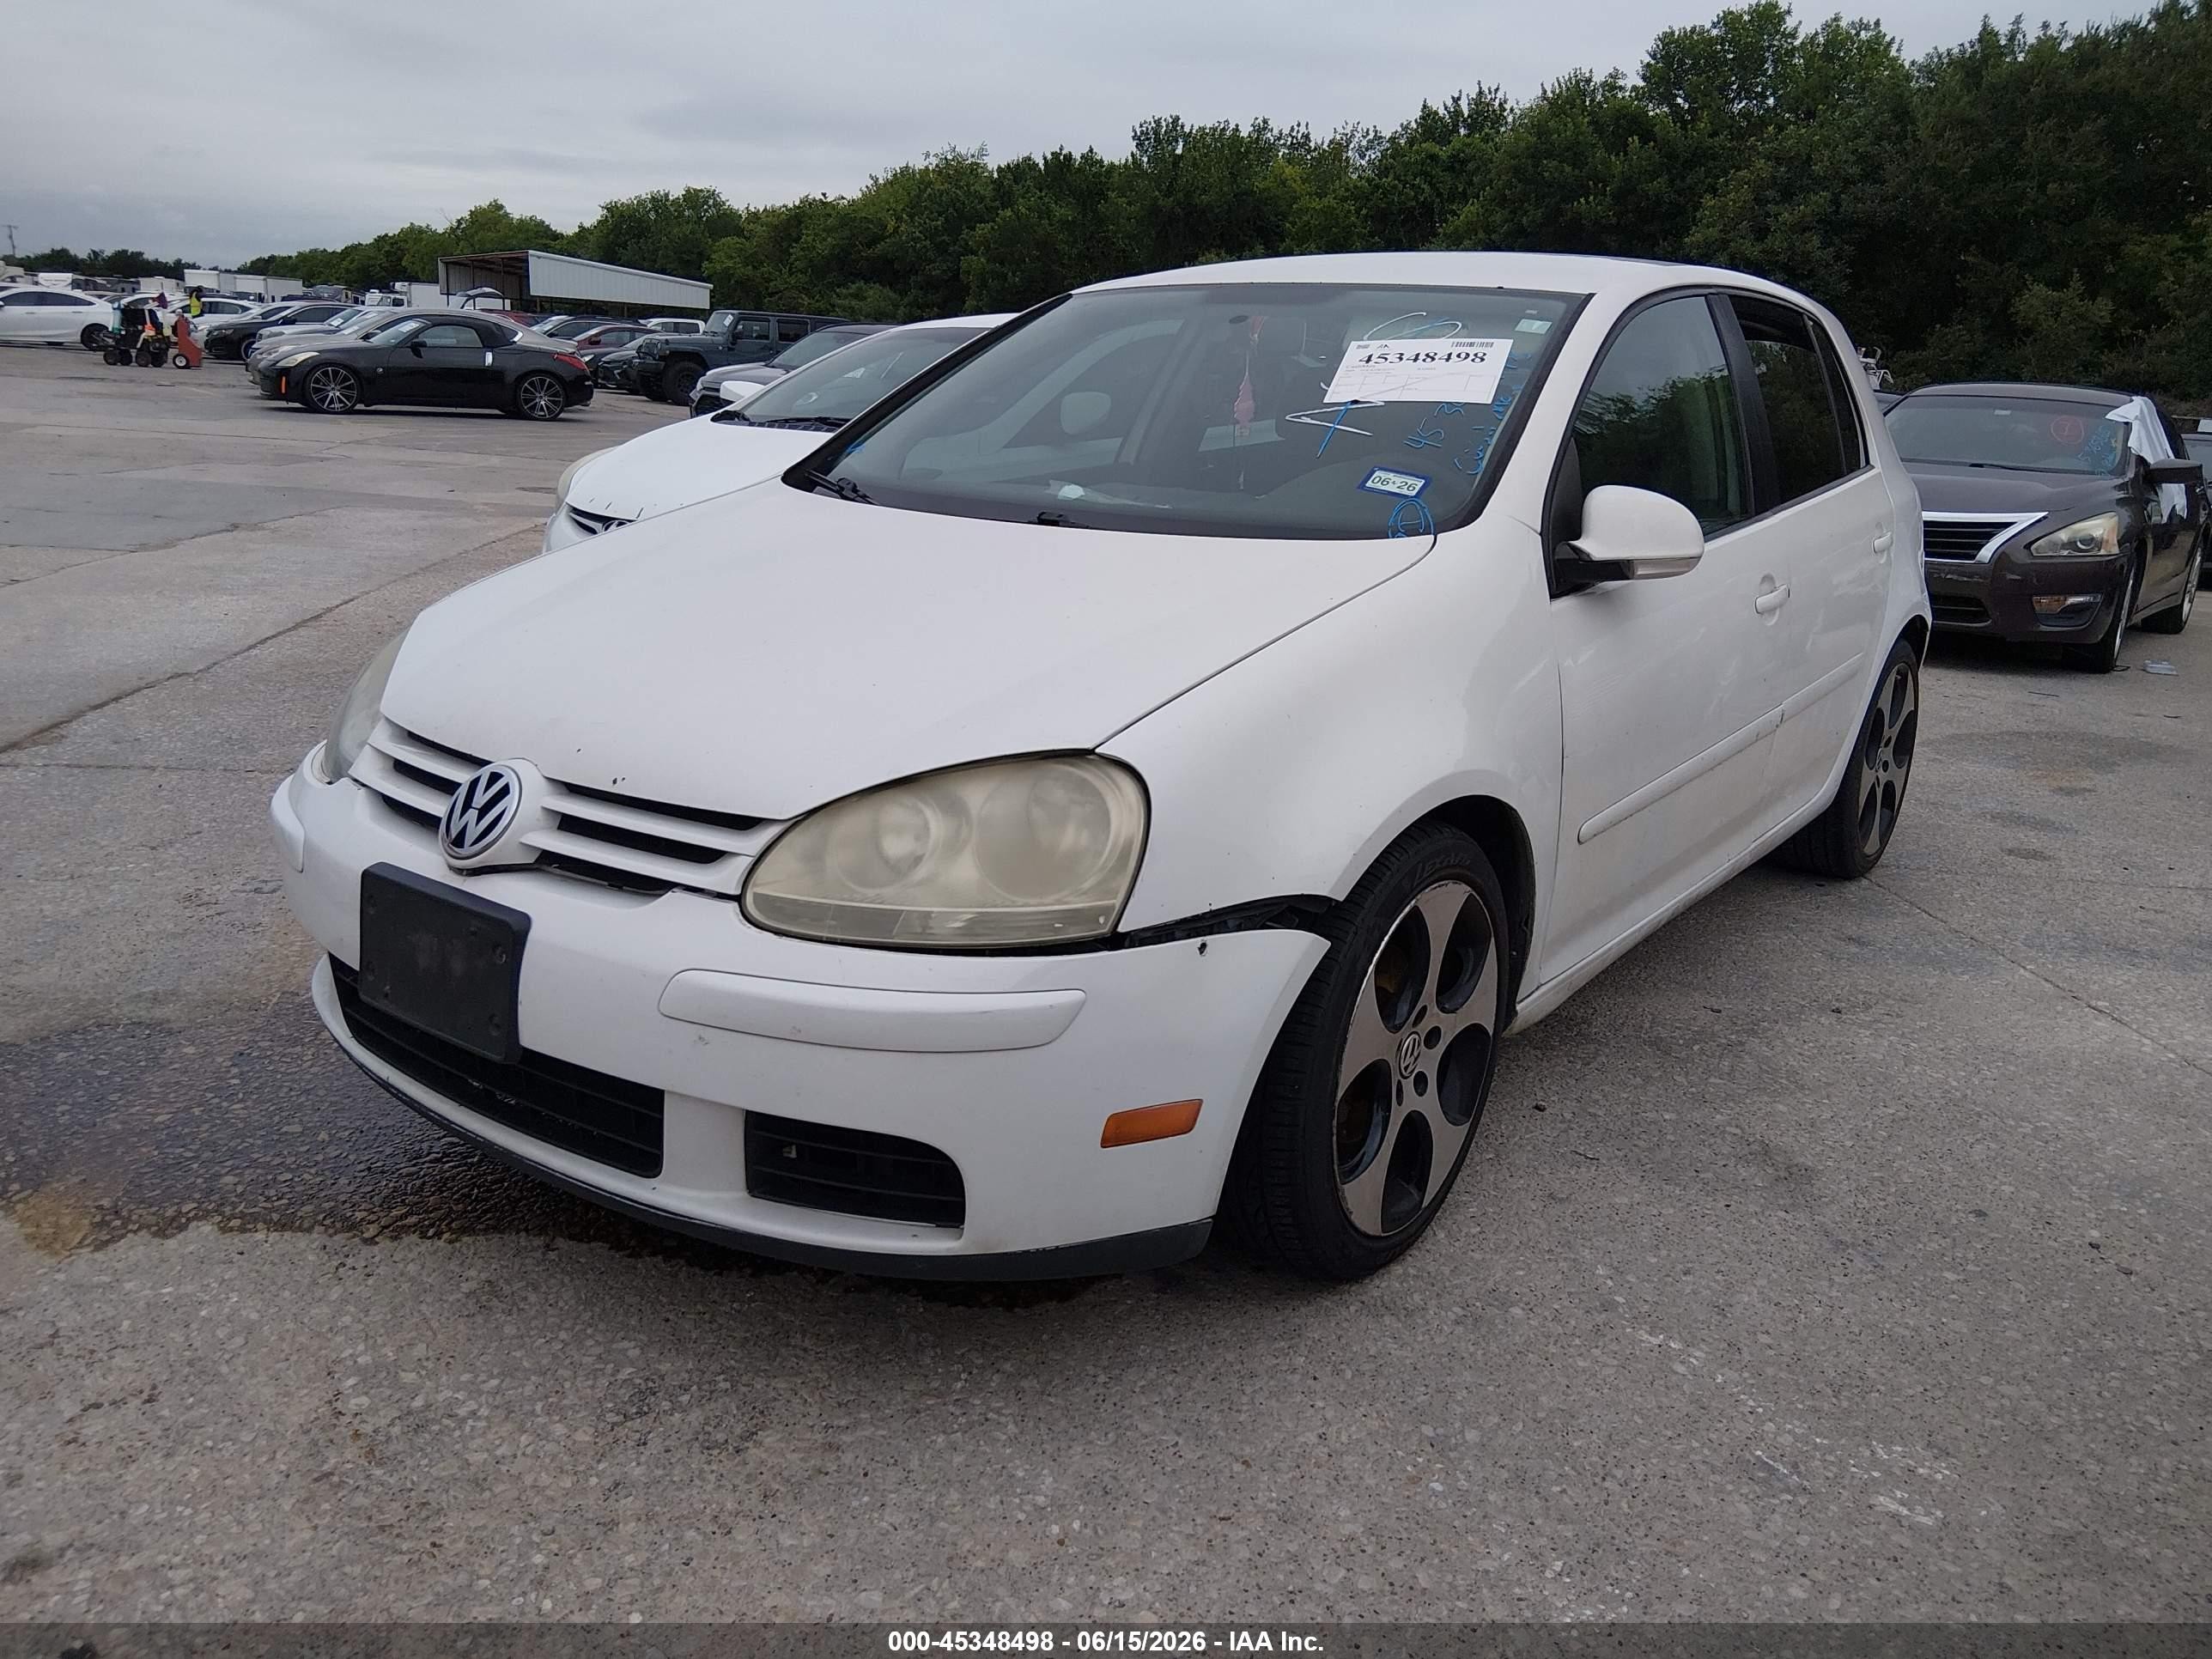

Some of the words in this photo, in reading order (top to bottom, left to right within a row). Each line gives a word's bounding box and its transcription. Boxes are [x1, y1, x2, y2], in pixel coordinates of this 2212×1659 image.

[1358, 350, 1488, 364] 45348498
[1370, 475, 1392, 486] 06
[1396, 480, 1419, 492] 26
